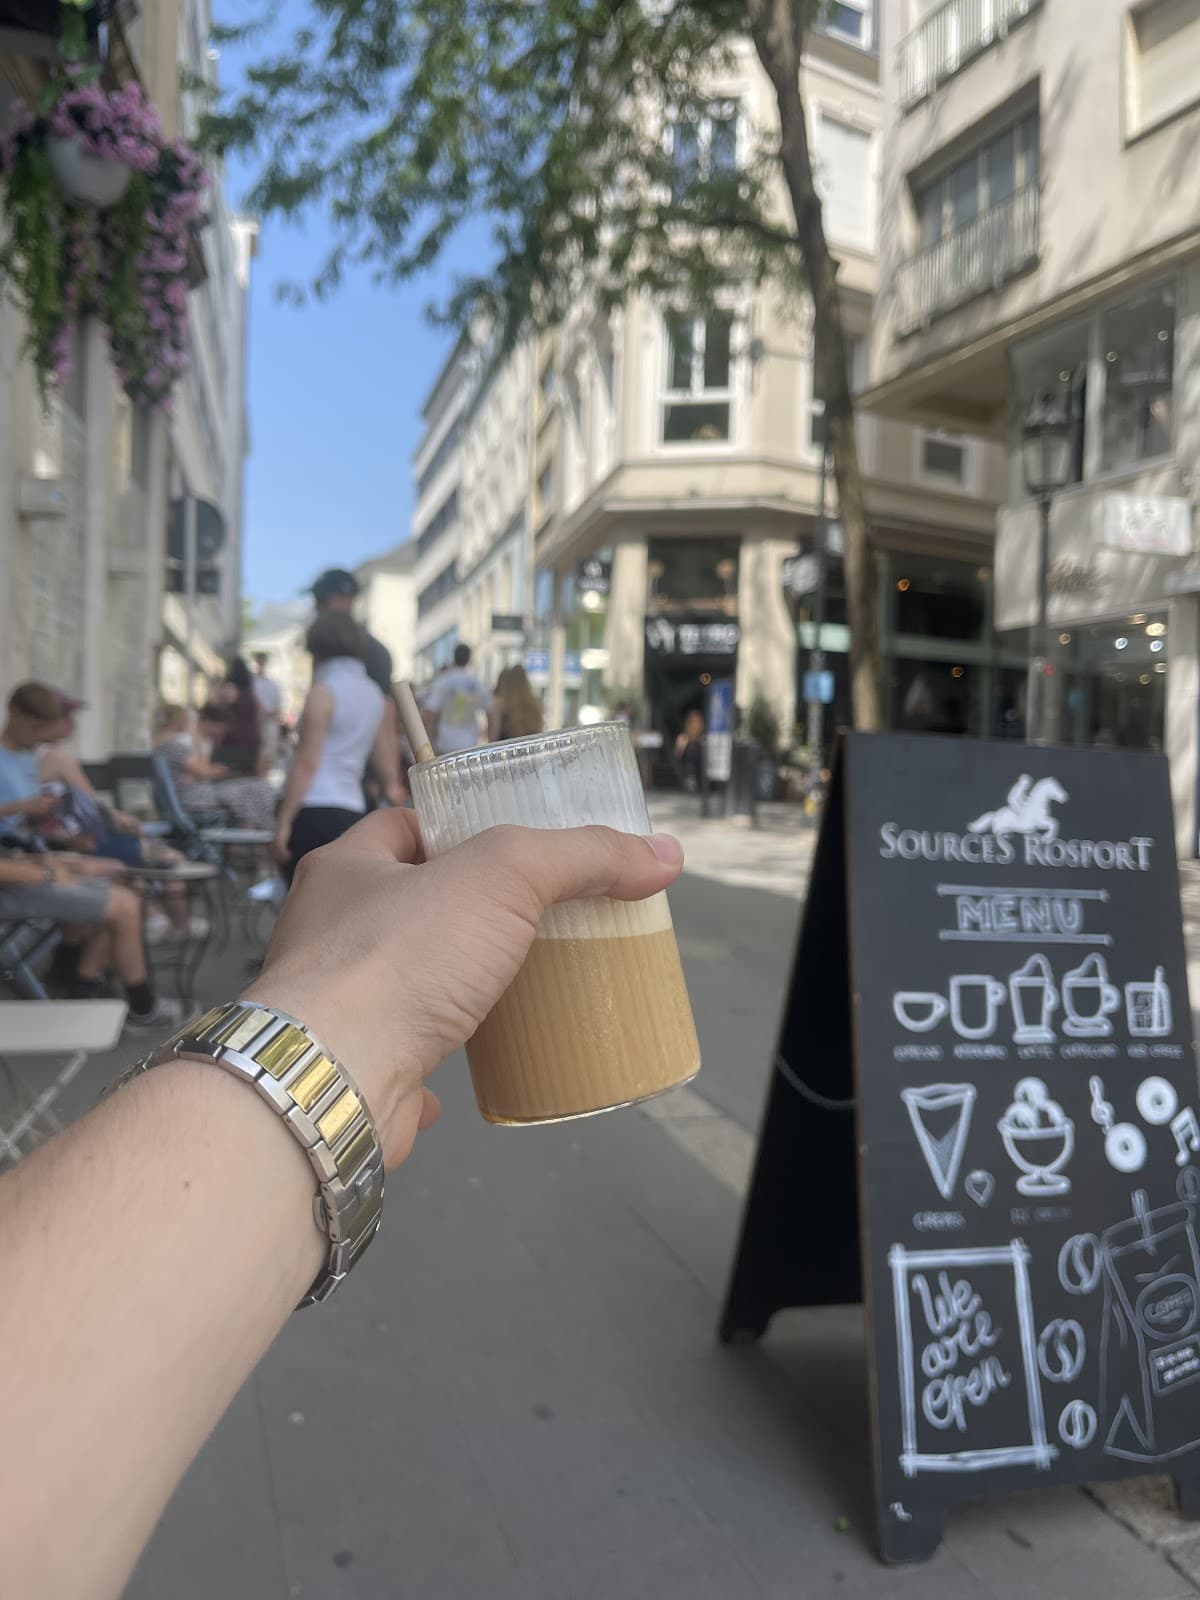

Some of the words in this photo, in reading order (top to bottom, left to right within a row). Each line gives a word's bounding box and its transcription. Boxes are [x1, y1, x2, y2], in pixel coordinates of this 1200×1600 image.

[879, 821, 1015, 865] SOURCES
[1024, 833, 1155, 871] ROSPORT
[955, 895, 1084, 934] MENU
[912, 1270, 982, 1335] We
[921, 1311, 1003, 1377] are
